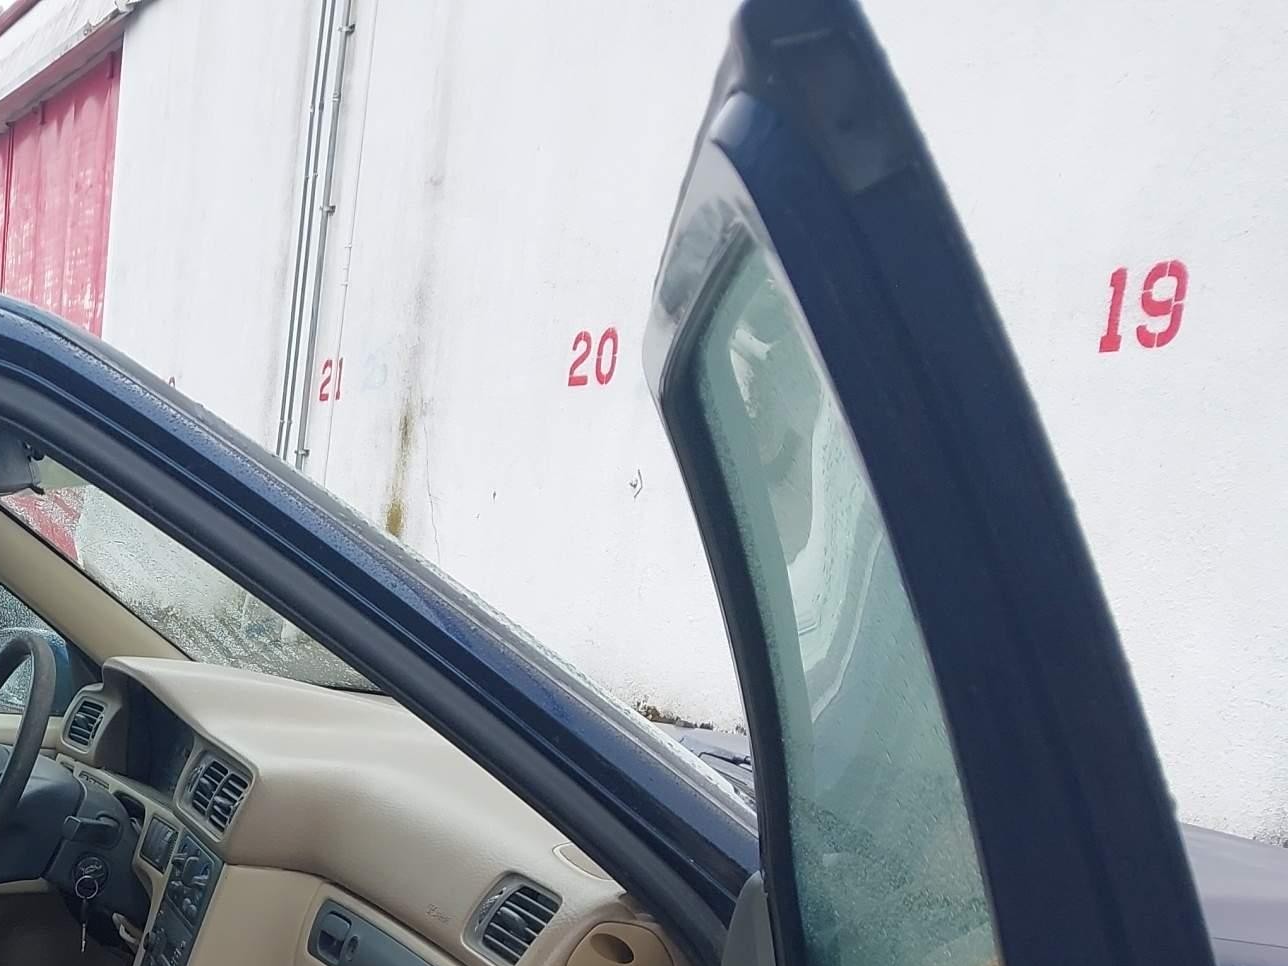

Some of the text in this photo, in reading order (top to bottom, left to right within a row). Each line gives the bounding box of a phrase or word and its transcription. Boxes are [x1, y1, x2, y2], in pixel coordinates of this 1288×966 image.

[1099, 260, 1189, 353] 19
[319, 357, 343, 401] 21
[568, 328, 618, 387] 20
